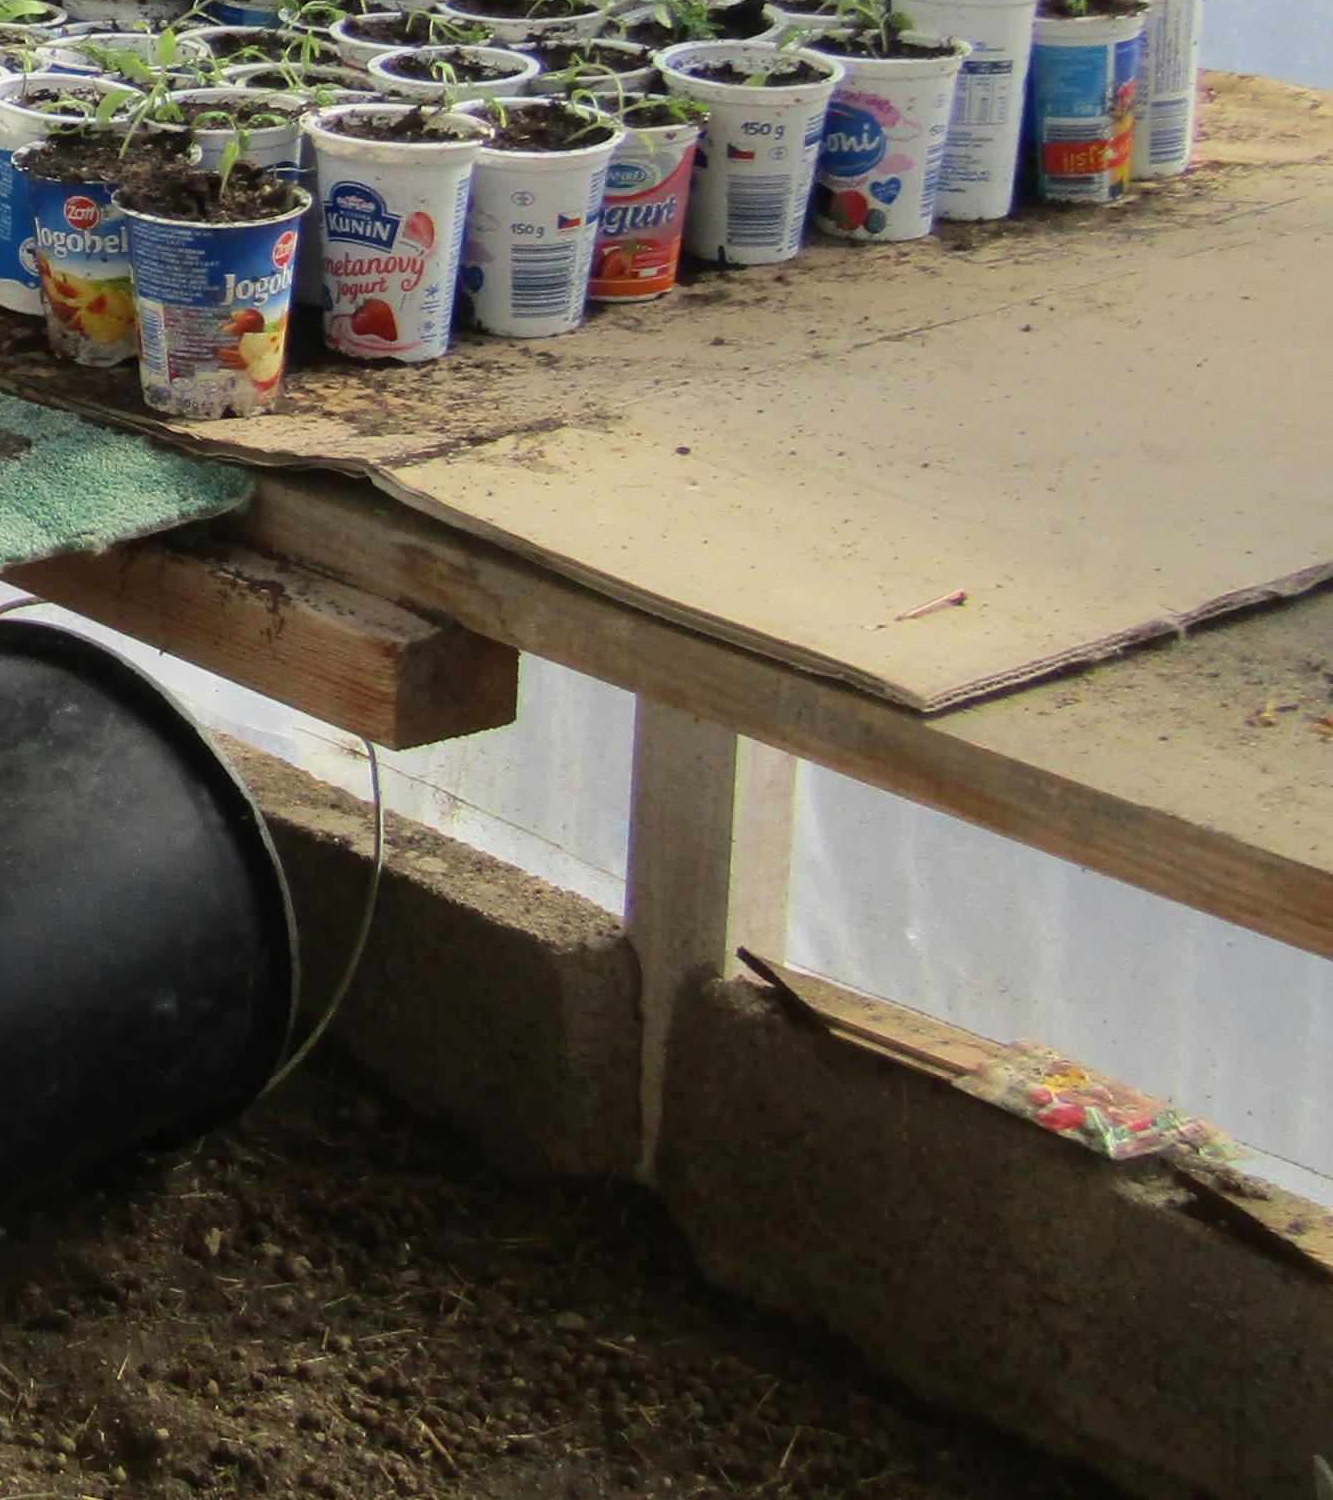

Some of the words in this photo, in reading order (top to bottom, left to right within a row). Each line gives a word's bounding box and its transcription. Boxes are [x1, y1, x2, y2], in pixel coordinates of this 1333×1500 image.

[740, 121, 772, 136] 150
[774, 124, 786, 141] g
[66, 205, 96, 222] Zott
[35, 216, 129, 259] Jogobel
[509, 221, 533, 236] 150
[534, 225, 546, 239] g
[335, 277, 389, 305] jogurt
